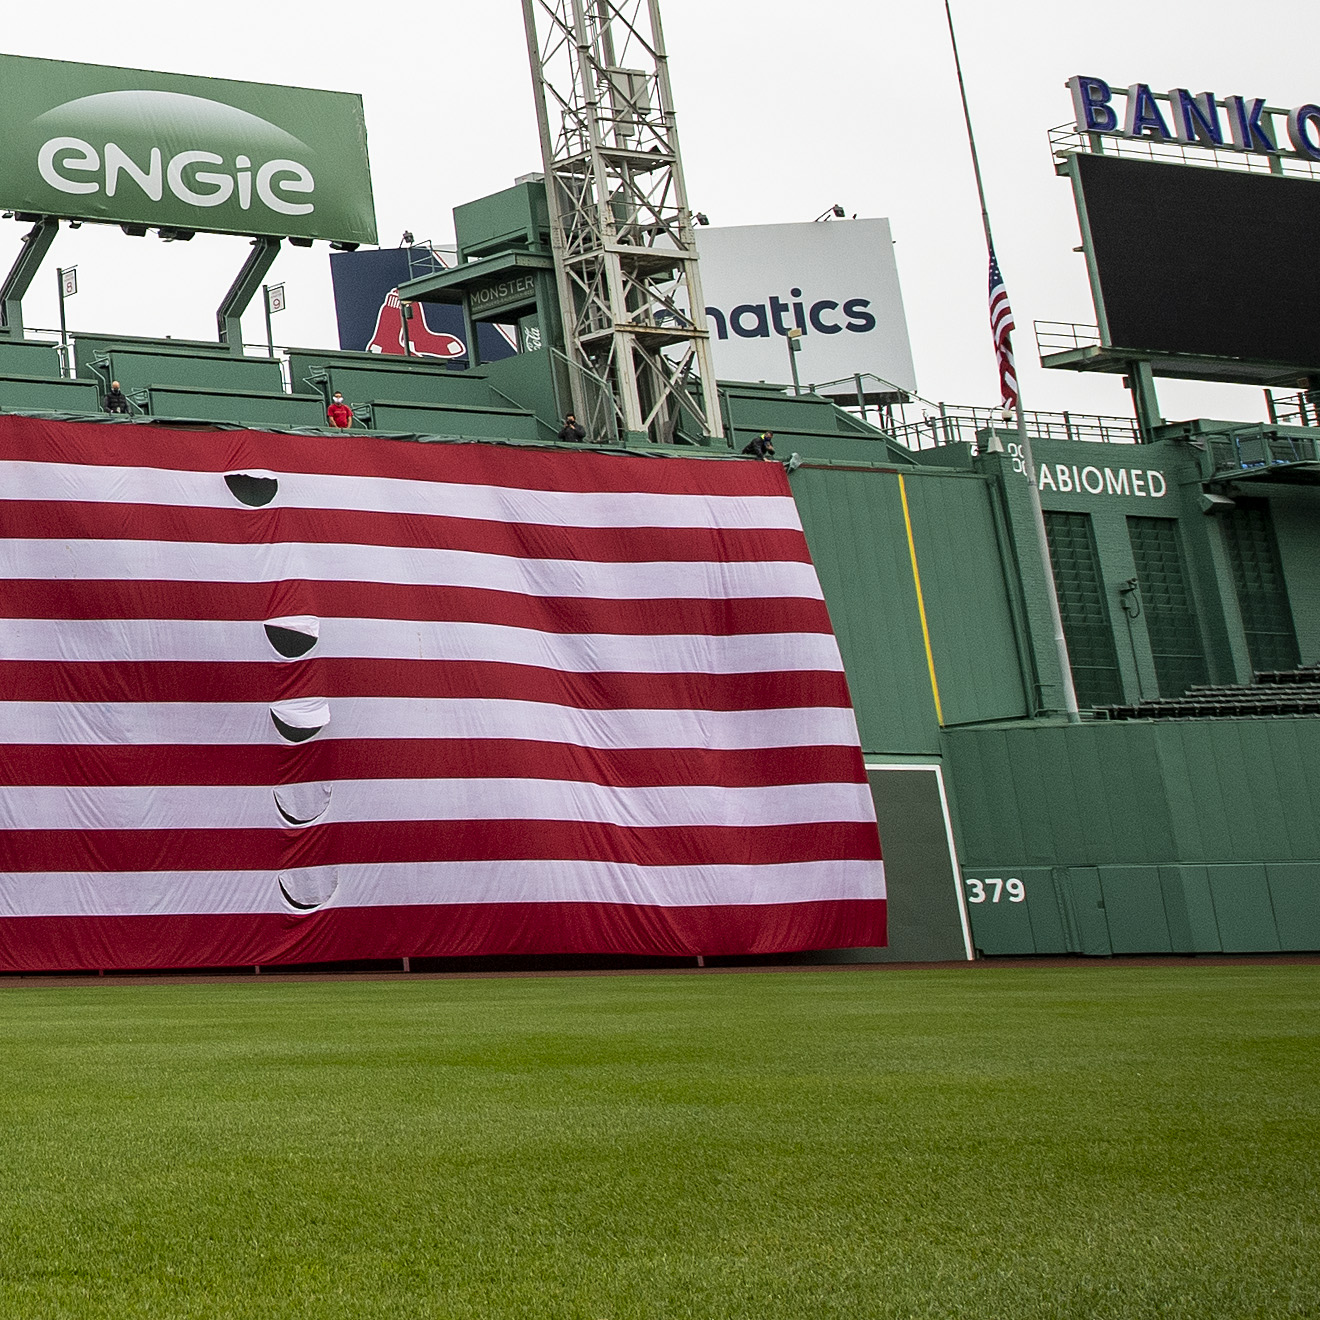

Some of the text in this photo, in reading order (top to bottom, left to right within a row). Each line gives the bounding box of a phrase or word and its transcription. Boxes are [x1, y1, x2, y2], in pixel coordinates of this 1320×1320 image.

[1068, 75, 1277, 153] BANK
[66, 282, 73, 293] 8
[469, 275, 535, 306] MONSTER
[272, 298, 281, 309] 9
[653, 286, 877, 341] natics
[1038, 463, 1168, 498] ABIOMED
[964, 877, 1026, 905] 379
